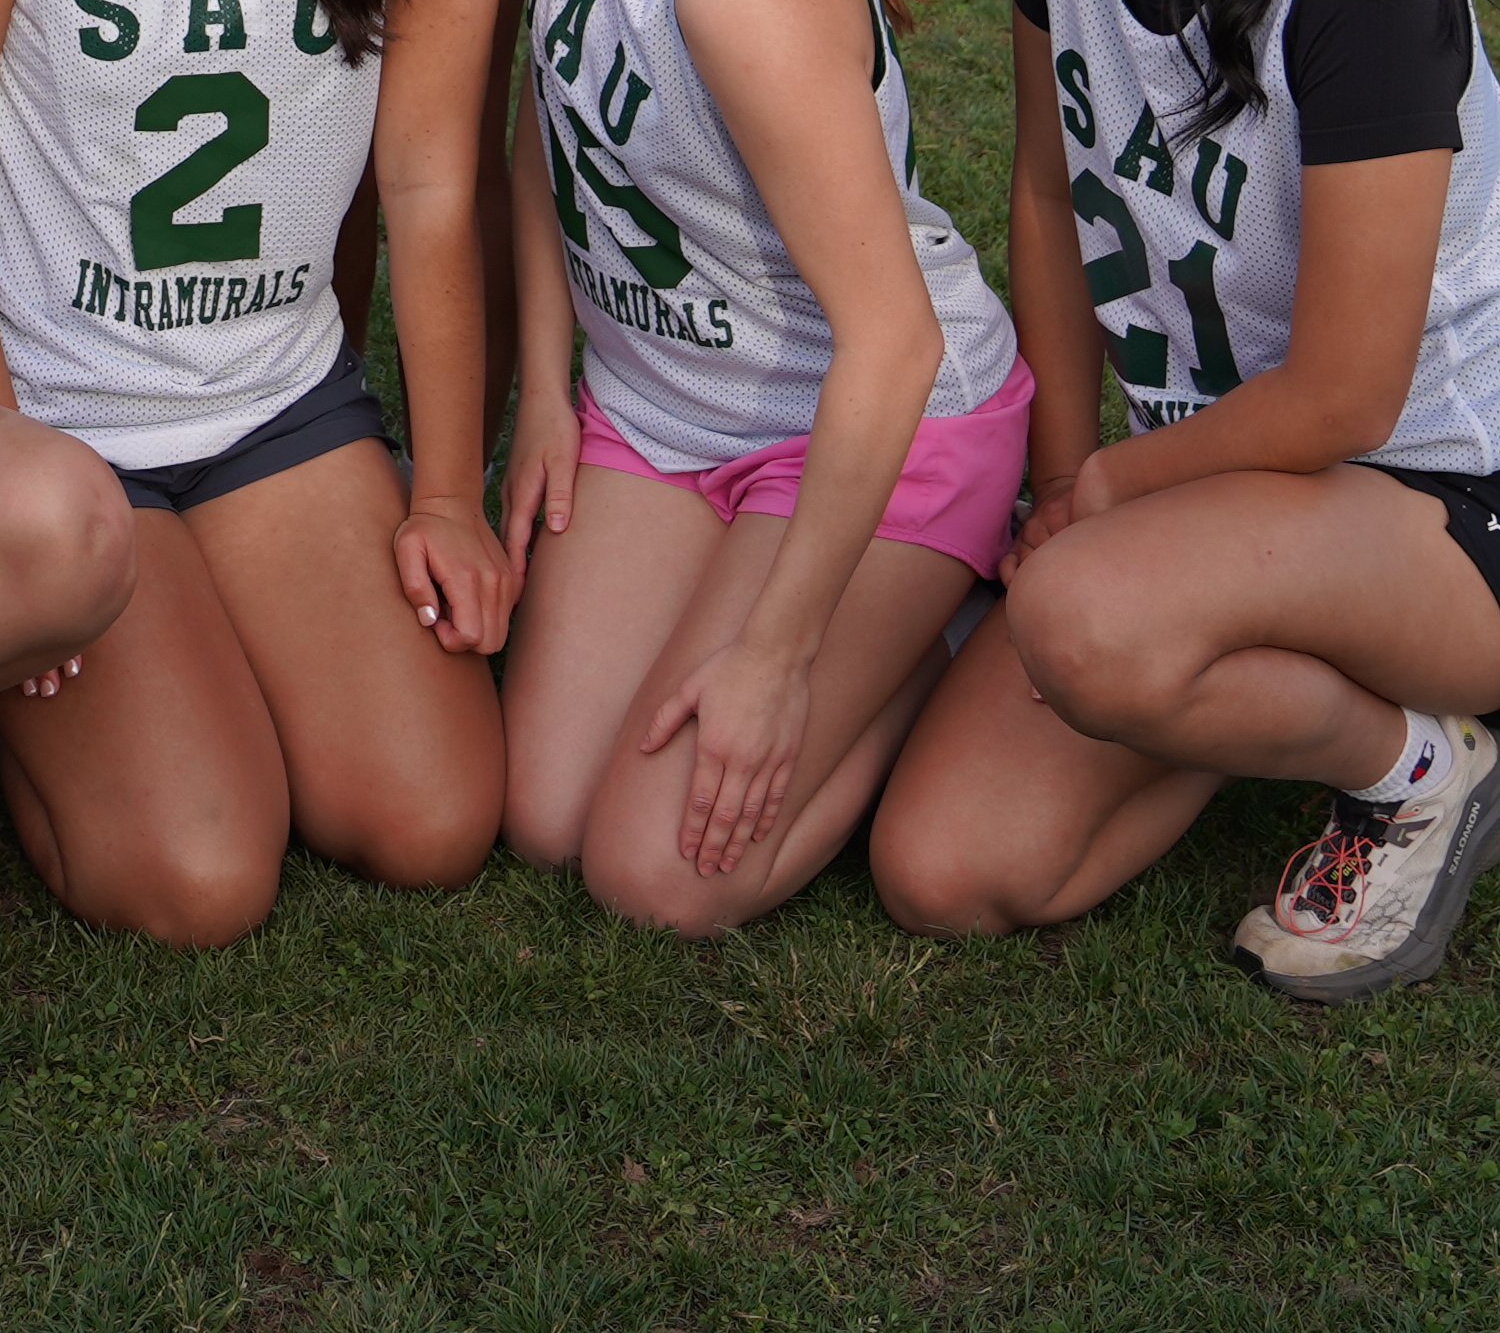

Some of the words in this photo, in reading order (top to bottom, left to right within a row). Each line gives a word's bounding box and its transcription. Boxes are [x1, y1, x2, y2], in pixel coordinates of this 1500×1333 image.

[130, 70, 270, 271] 2
[1056, 48, 1248, 242] SAU
[71, 258, 311, 331] INTRAMURALS
[1071, 167, 1244, 397] 21
[1448, 800, 1482, 877] SALOMON
